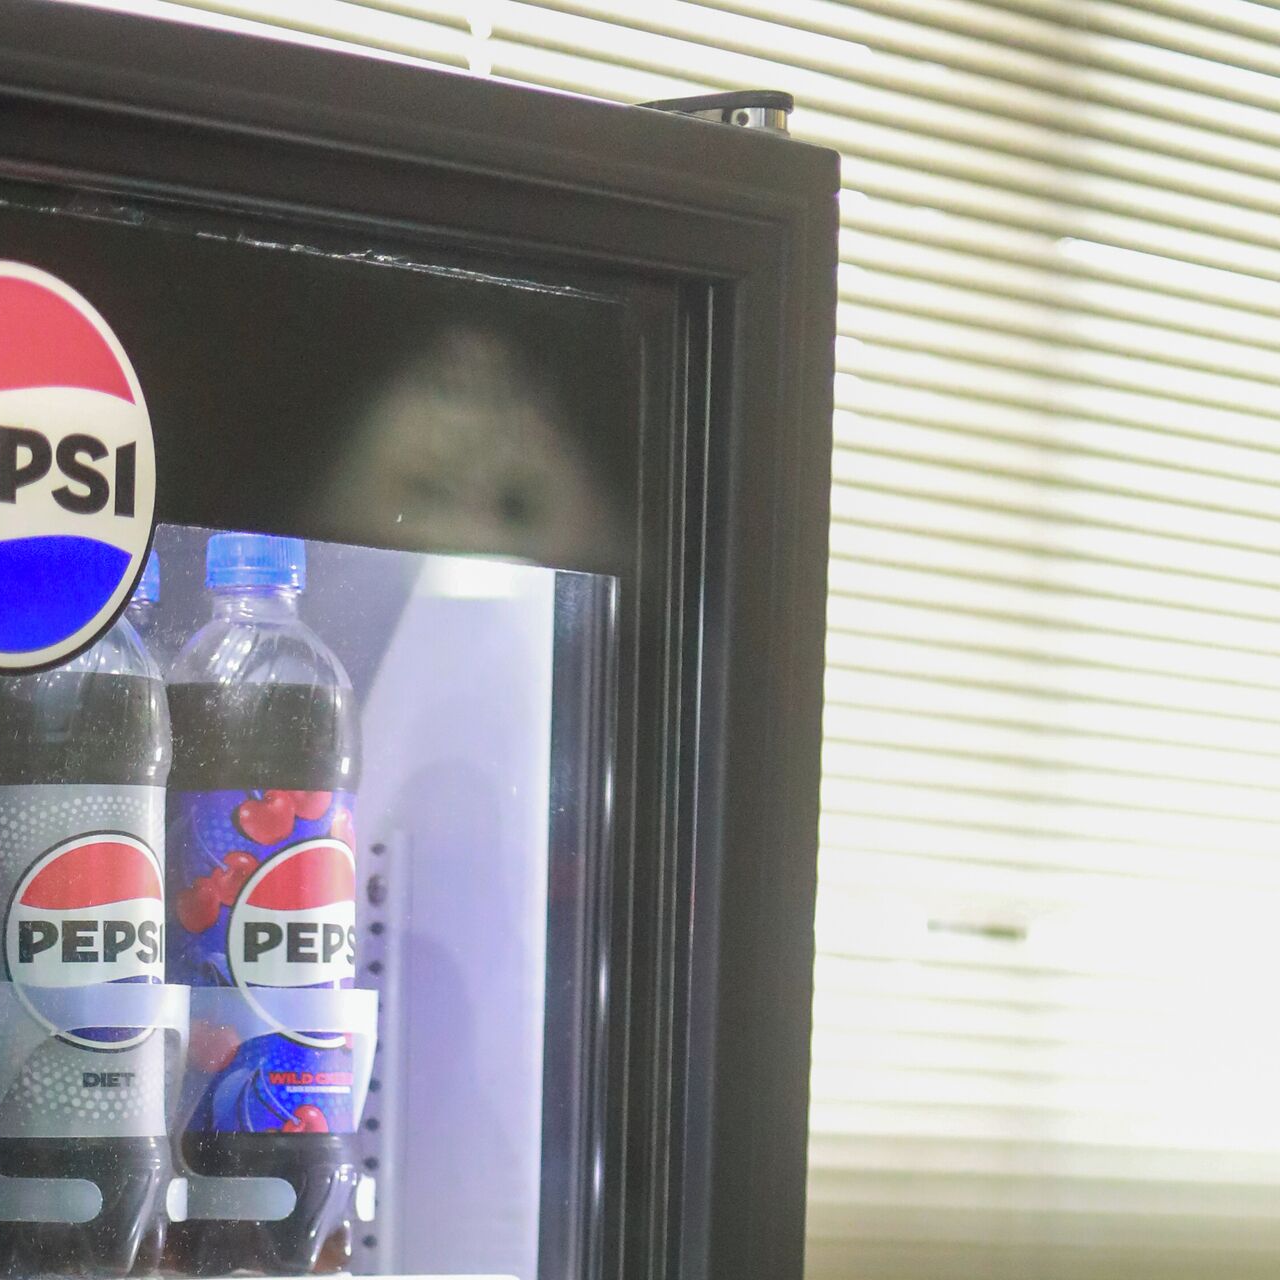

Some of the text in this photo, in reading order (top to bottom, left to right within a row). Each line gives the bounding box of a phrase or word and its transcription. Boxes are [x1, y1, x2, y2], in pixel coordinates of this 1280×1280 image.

[243, 921, 356, 965] PEPS
[82, 1072, 135, 1088] DIET
[269, 1071, 313, 1086] WILD
